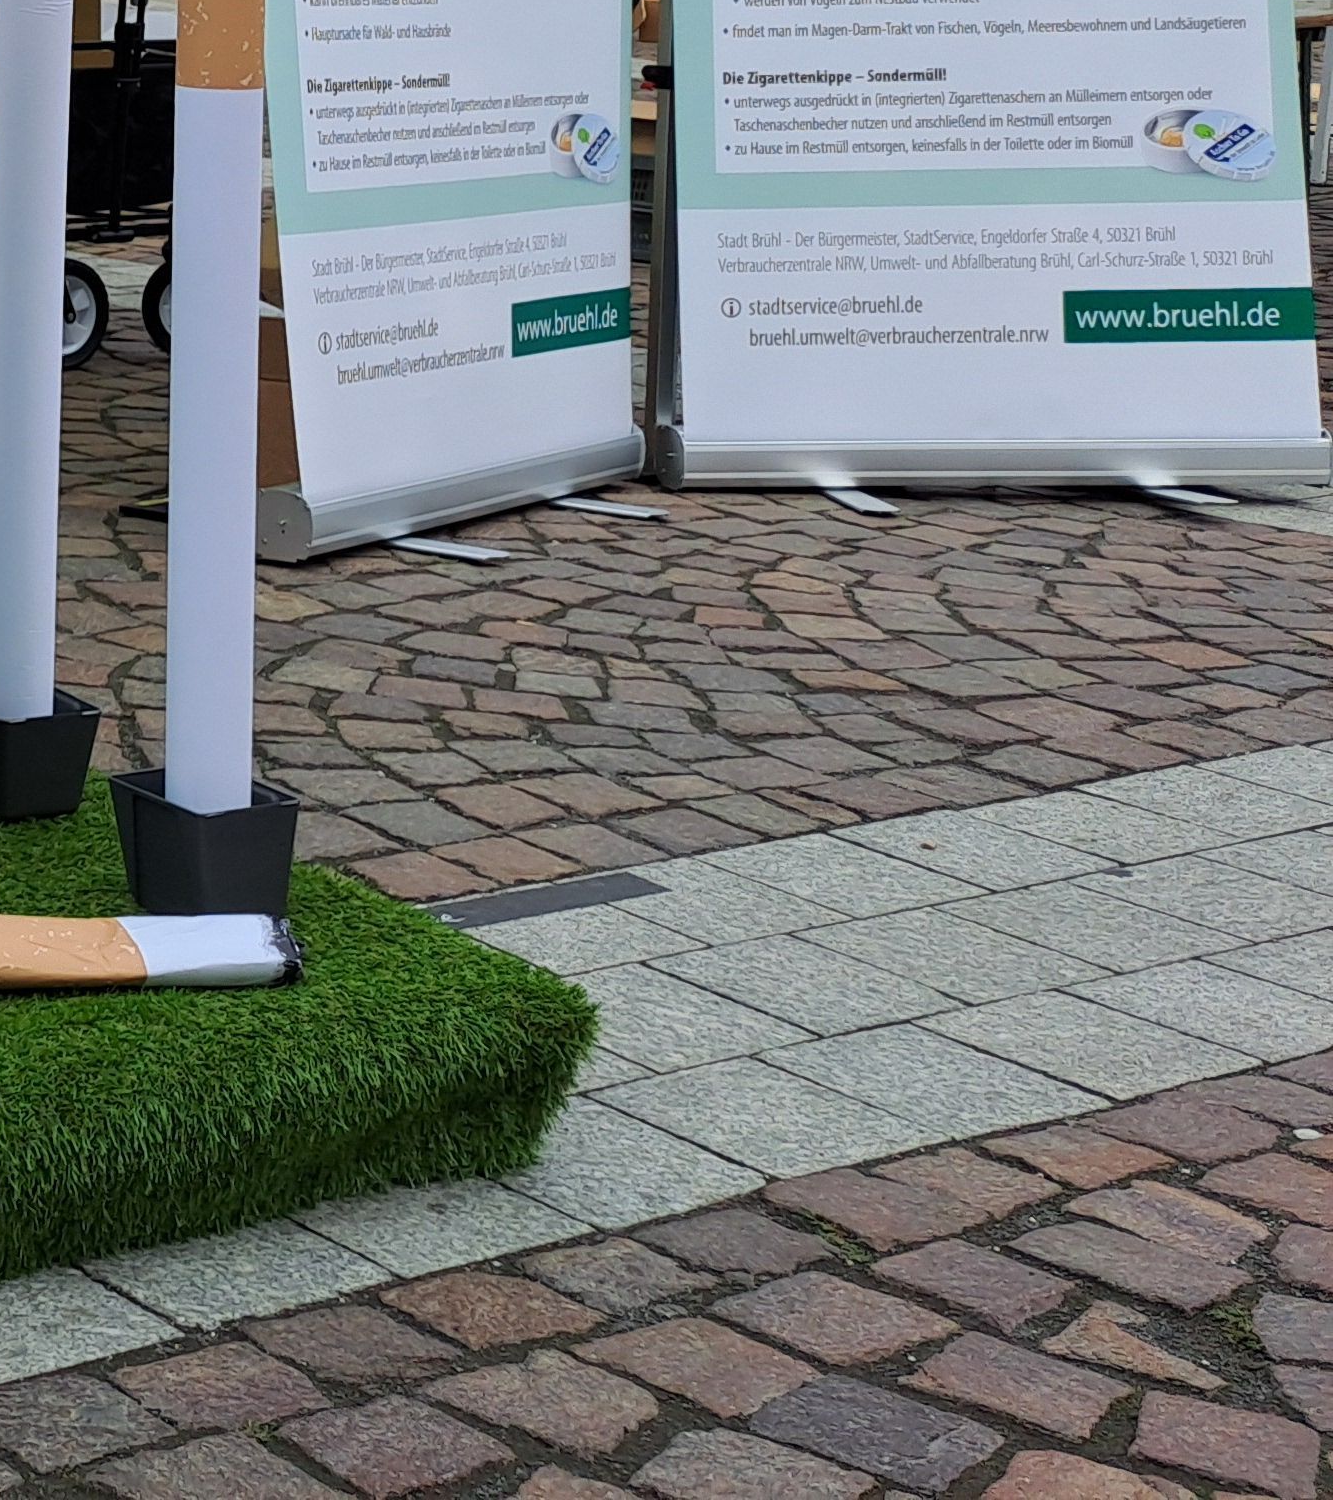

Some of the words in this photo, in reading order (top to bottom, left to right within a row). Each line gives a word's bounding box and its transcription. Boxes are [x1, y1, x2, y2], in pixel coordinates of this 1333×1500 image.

[722, 71, 744, 84] Die
[747, 69, 852, 87] Zigarettenkippe
[867, 67, 946, 82] Sondermüll!
[748, 295, 922, 316] stadtservice@bruehl.de
[1075, 301, 1282, 329] www.bruehl.de
[336, 318, 439, 352] stadtservice@bruehl.de
[517, 304, 618, 341] www.bruehl.de
[749, 324, 1049, 347] bruehl.umwelt@verbraucherzentrale.nrw
